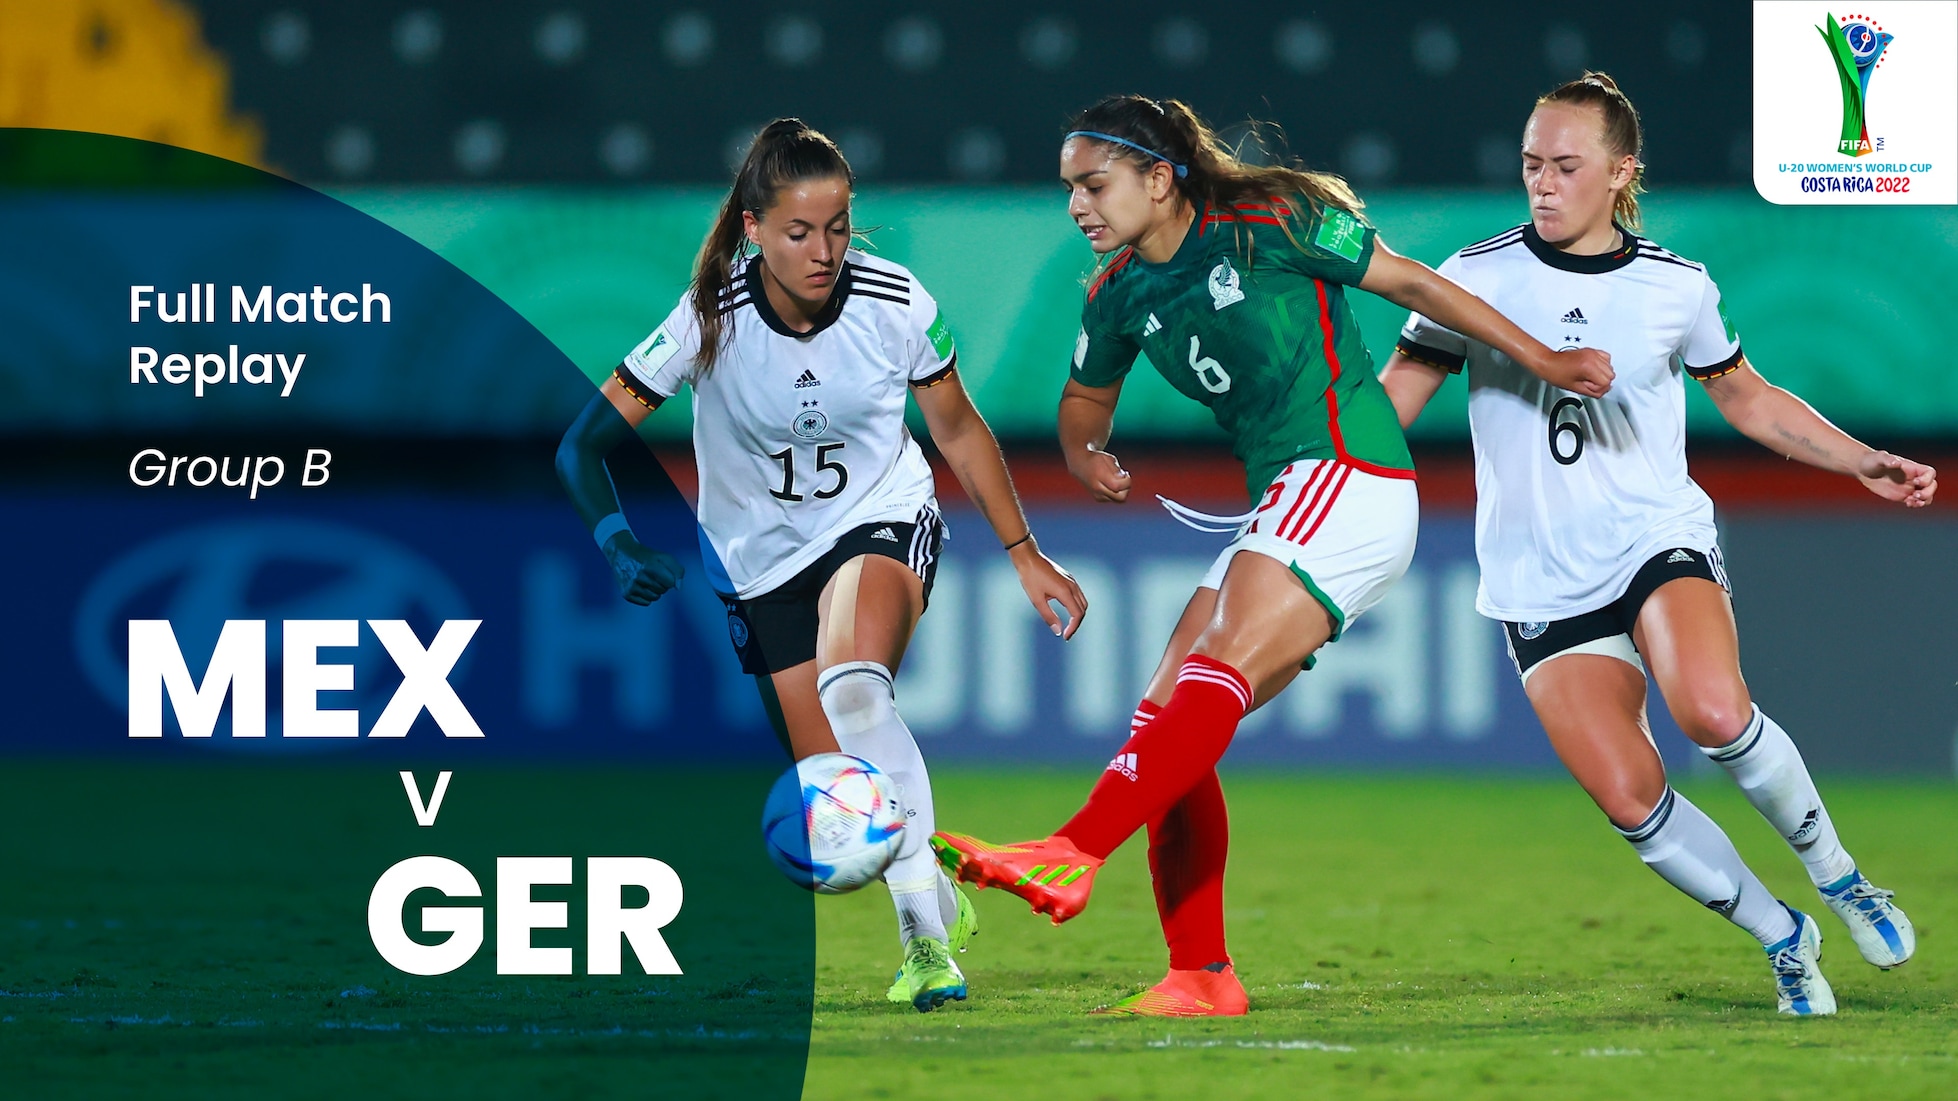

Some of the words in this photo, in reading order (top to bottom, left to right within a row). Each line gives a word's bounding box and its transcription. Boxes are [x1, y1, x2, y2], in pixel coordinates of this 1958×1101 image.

[1560, 316, 1588, 325] adidas
[794, 380, 821, 389] adidas
[1189, 334, 1231, 394] 6
[1548, 396, 1584, 466] 6
[768, 442, 849, 502] 15
